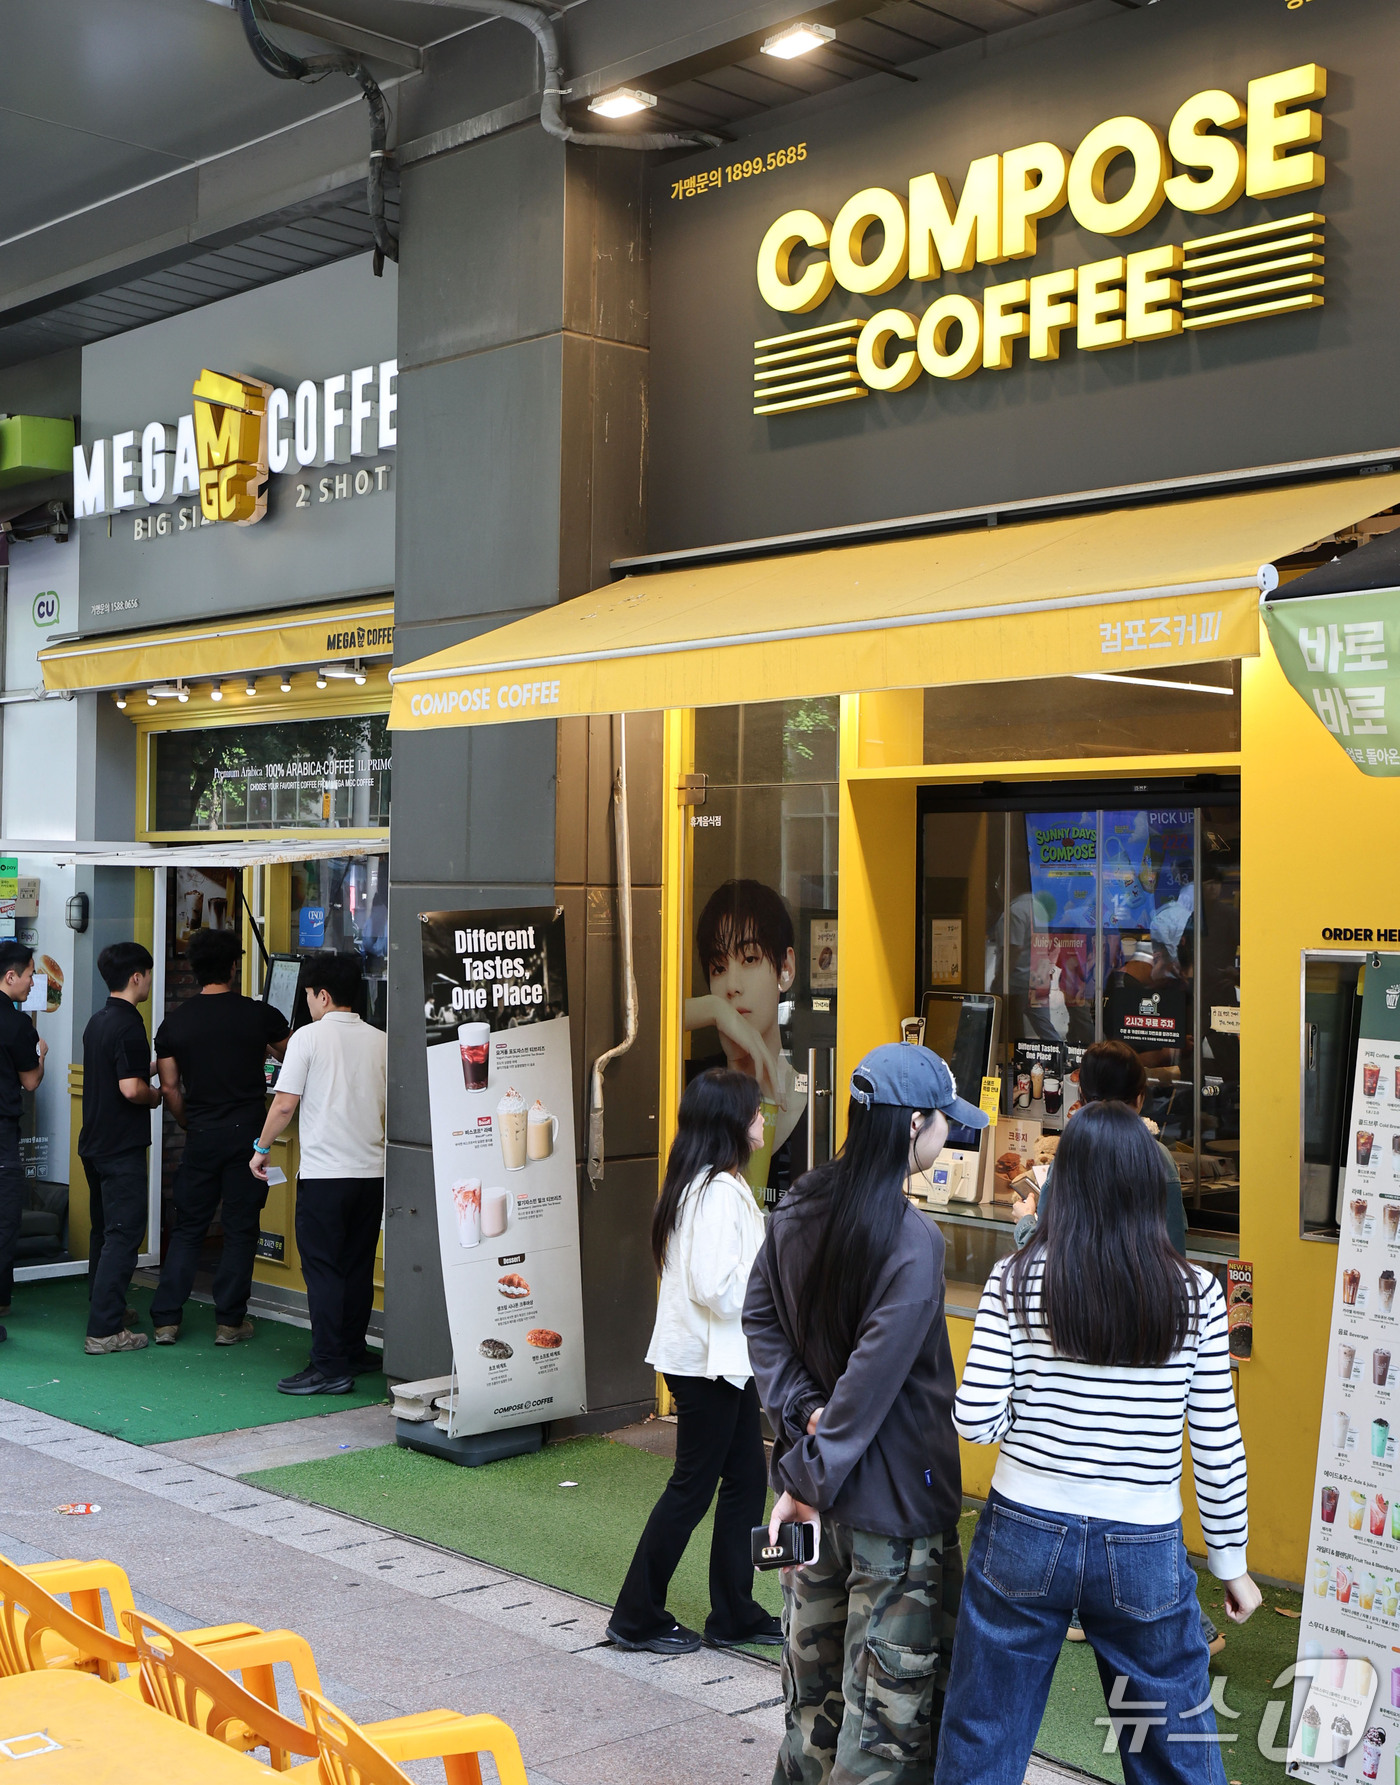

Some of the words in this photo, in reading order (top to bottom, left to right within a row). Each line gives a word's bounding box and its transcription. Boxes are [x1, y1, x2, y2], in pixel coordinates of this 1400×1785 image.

[671, 167, 722, 199] 가맹문의
[725, 142, 807, 183] 1899.5685
[756, 62, 1328, 314] COMPOSE
[855, 243, 1185, 392] COFFEE
[73, 414, 200, 520] MEGA
[296, 483, 311, 509] 2
[319, 465, 392, 503] SHOT
[134, 512, 172, 541] BIG
[37, 600, 55, 619] CU
[327, 631, 356, 651] MEGA
[1099, 611, 1222, 653] 컴포즈커피
[1298, 620, 1388, 674] 바로
[410, 687, 490, 717] COMPOSE
[497, 680, 560, 709] COFFEE
[1312, 686, 1388, 736] 바로
[265, 763, 284, 777] 100%
[286, 760, 322, 777] ARABICA
[323, 759, 354, 775] COFFEE
[690, 815, 721, 827] 휴게음식점
[1149, 812, 1177, 824] PICK
[1180, 812, 1194, 824] UP
[1035, 828, 1071, 845] SUNNY
[1071, 827, 1096, 842] DAYS
[1162, 834, 1188, 849] 222
[1040, 843, 1096, 863] COMPOSE
[454, 926, 536, 954] Different
[1033, 936, 1052, 950] Juicy
[1053, 937, 1084, 948] Summer
[1321, 927, 1373, 942] ORDER
[1376, 928, 1400, 942] HE
[462, 956, 530, 982] Tastes,
[451, 985, 487, 1011] One
[492, 983, 543, 1008] Place
[1125, 1017, 1143, 1026] 2시간
[1145, 1018, 1159, 1027] 무료
[1160, 1019, 1174, 1028] 주차
[1017, 1042, 1040, 1051] Different
[1026, 1051, 1036, 1059] One
[1036, 1052, 1051, 1061] Place
[503, 1256, 521, 1265] Dessert
[493, 1402, 524, 1414] COMPOSE
[531, 1396, 554, 1407] COFFEE
[1308, 1620, 1324, 1631] 스무디
[1346, 1632, 1367, 1643] Smoothie
